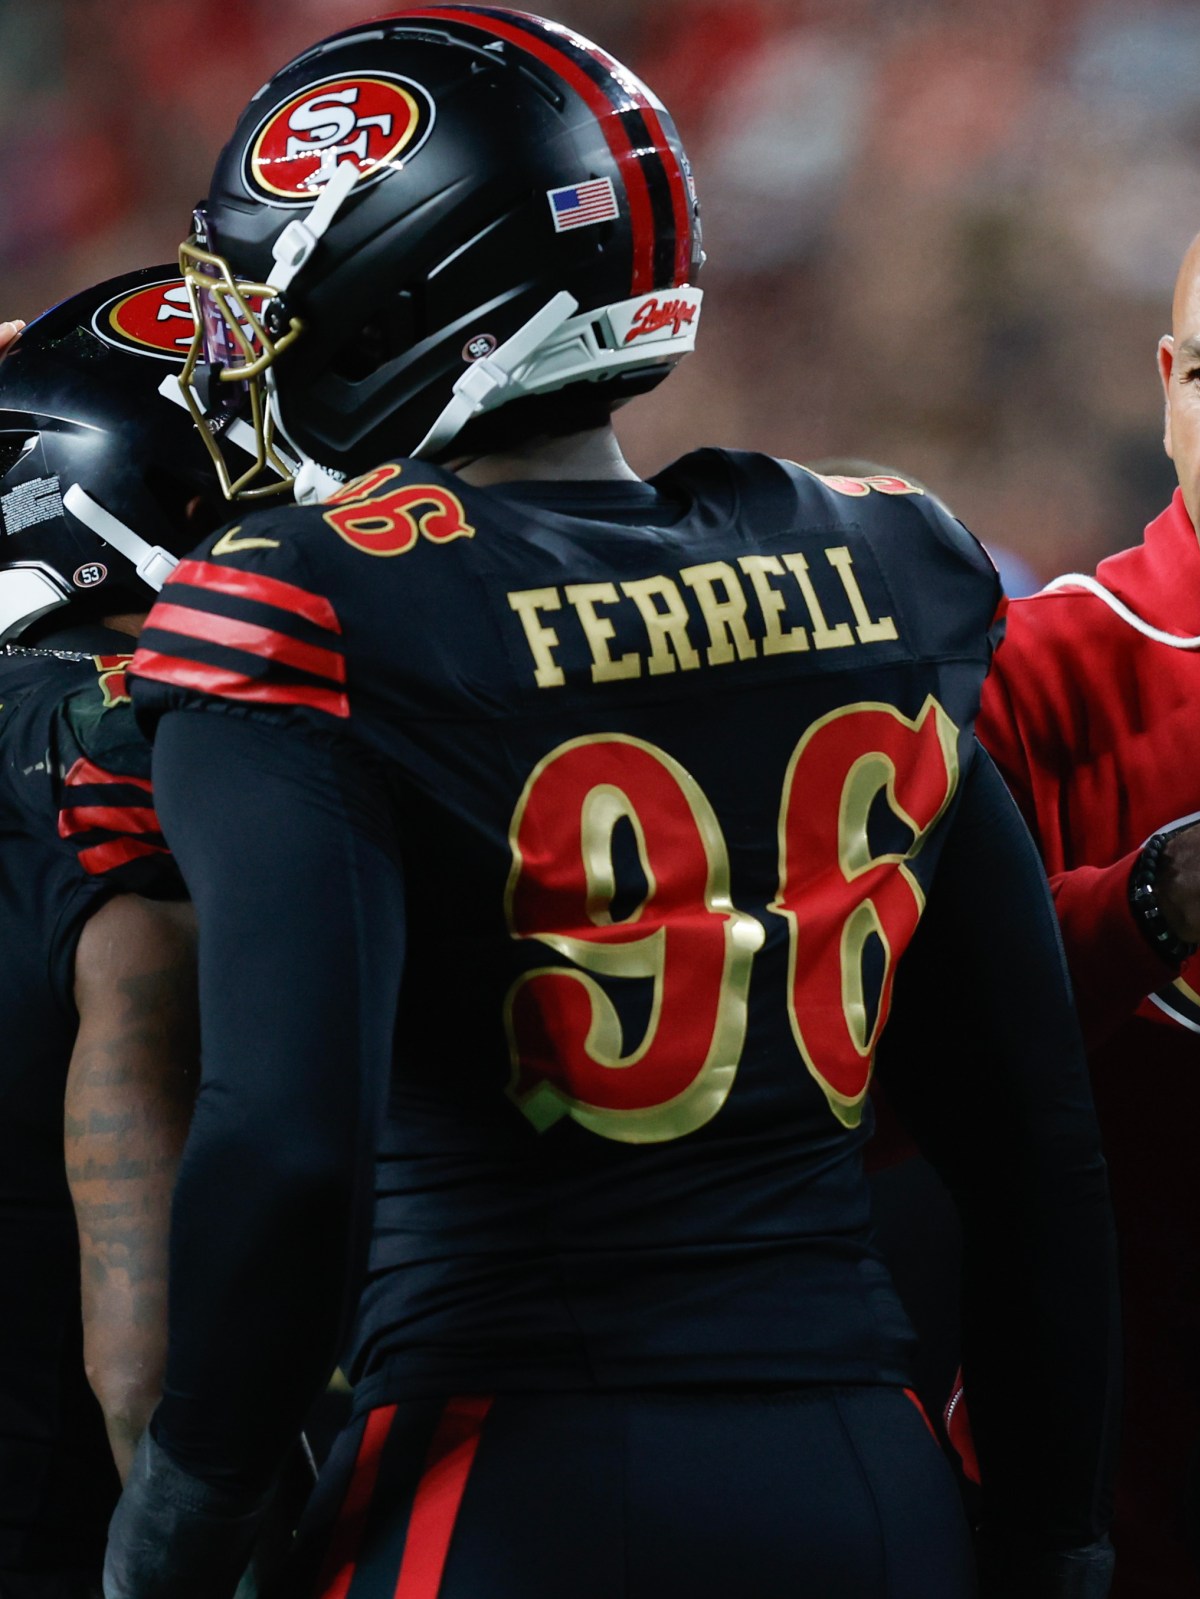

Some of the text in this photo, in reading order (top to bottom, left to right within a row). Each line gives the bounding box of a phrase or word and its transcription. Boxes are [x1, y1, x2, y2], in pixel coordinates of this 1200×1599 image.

[82, 566, 100, 583] 53
[507, 546, 899, 688] FERRELL
[504, 693, 960, 1144] 96
